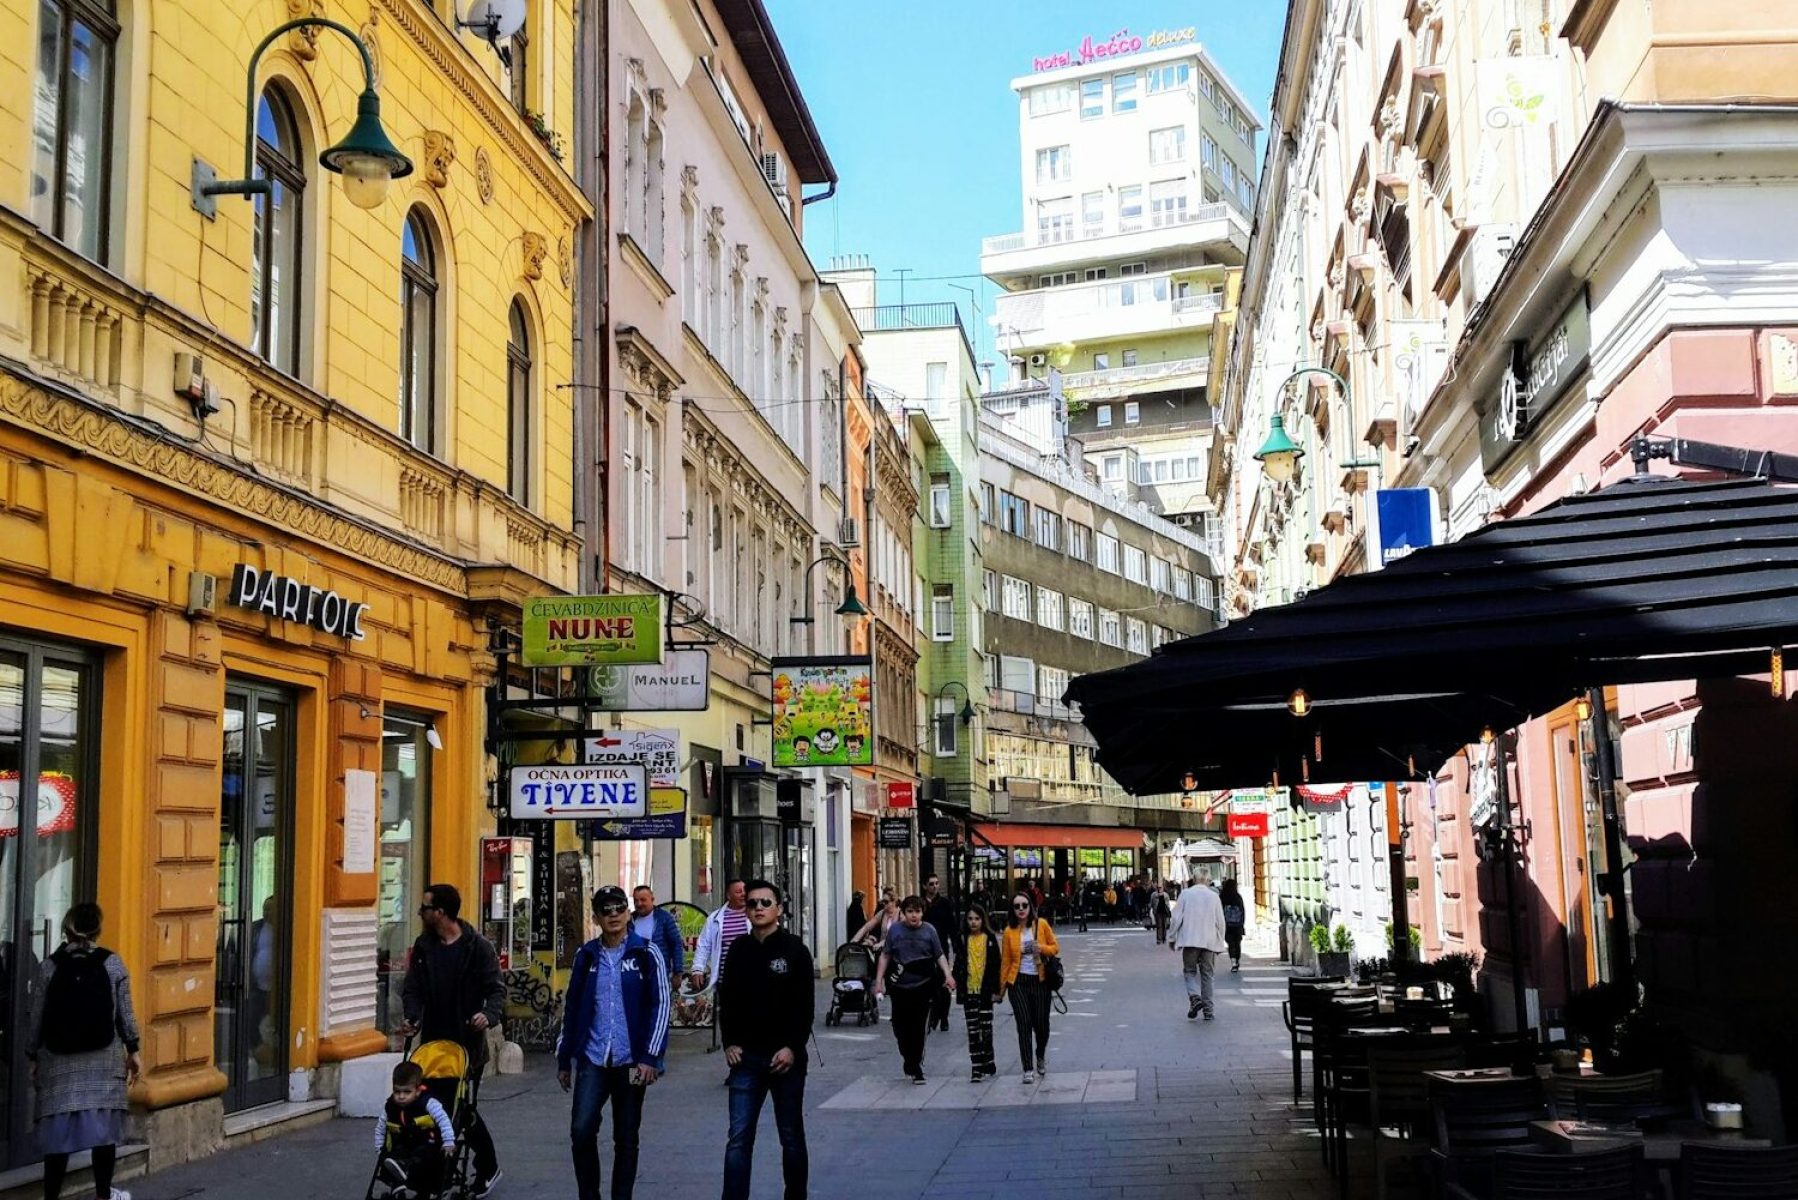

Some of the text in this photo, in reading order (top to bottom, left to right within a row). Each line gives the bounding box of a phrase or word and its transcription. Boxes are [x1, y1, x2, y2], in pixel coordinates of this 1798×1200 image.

[1034, 50, 1070, 71] hotel
[235, 564, 371, 641] PARFOIS
[549, 618, 634, 640] NUNE
[589, 751, 675, 762] IZDAJE SE
[528, 767, 630, 780] OČNA OPTIKA
[540, 863, 549, 909] SHISHA
[540, 918, 549, 941] BAR
